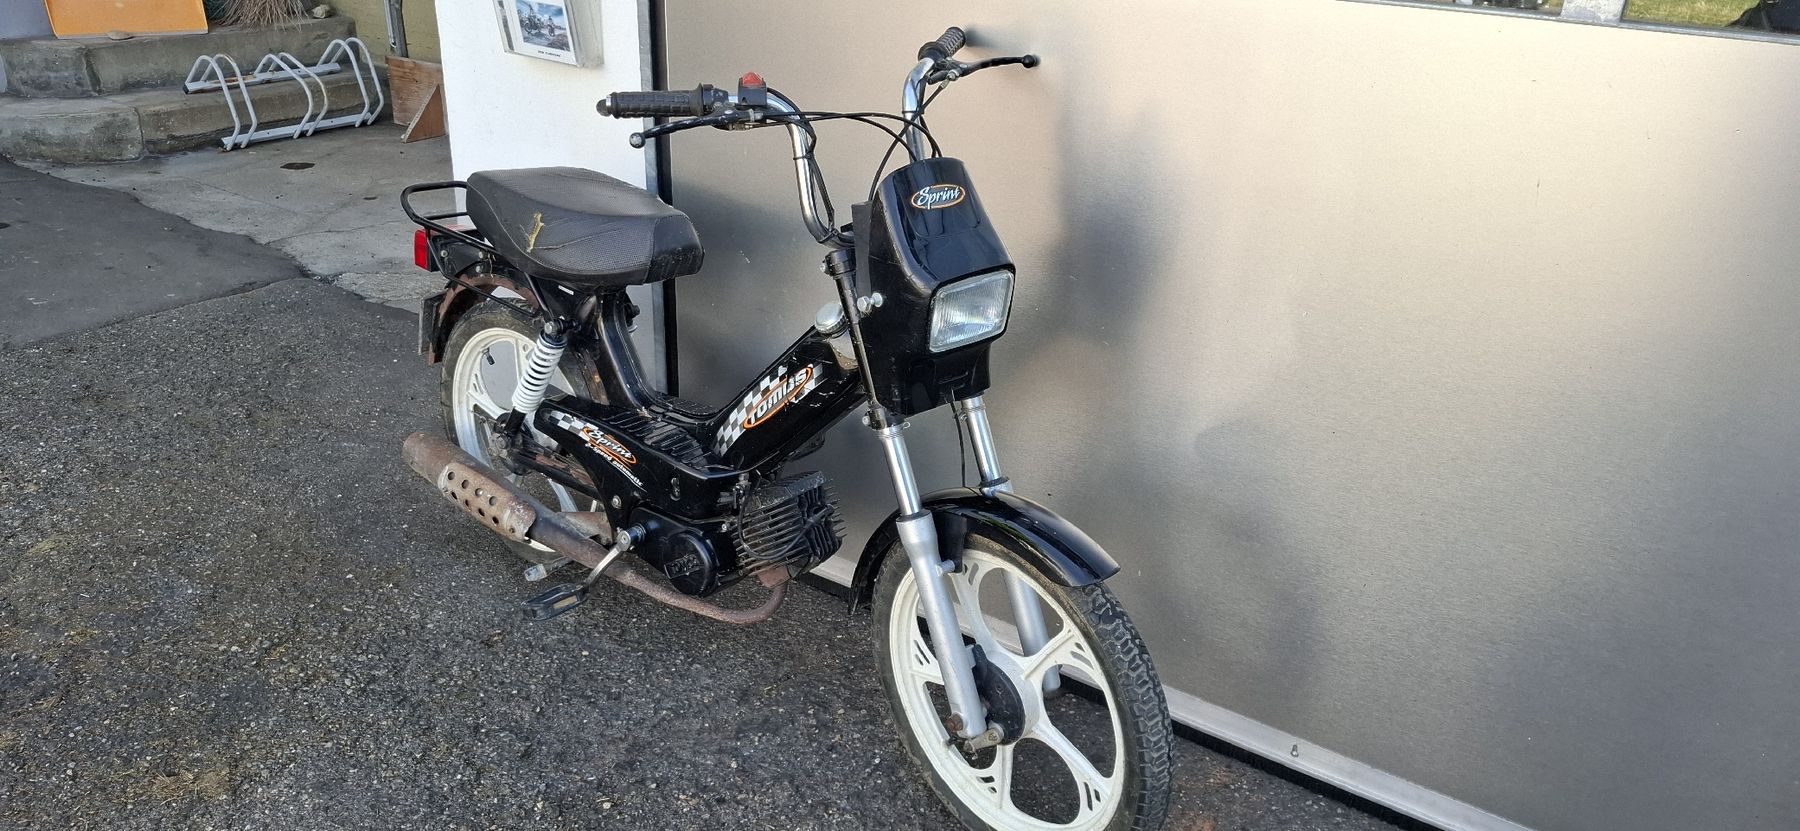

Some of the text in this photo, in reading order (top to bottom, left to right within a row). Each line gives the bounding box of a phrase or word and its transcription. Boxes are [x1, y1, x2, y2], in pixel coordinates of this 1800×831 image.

[917, 186, 960, 210] Sprint
[589, 430, 632, 458] Sprint
[612, 460, 643, 487] automatic
